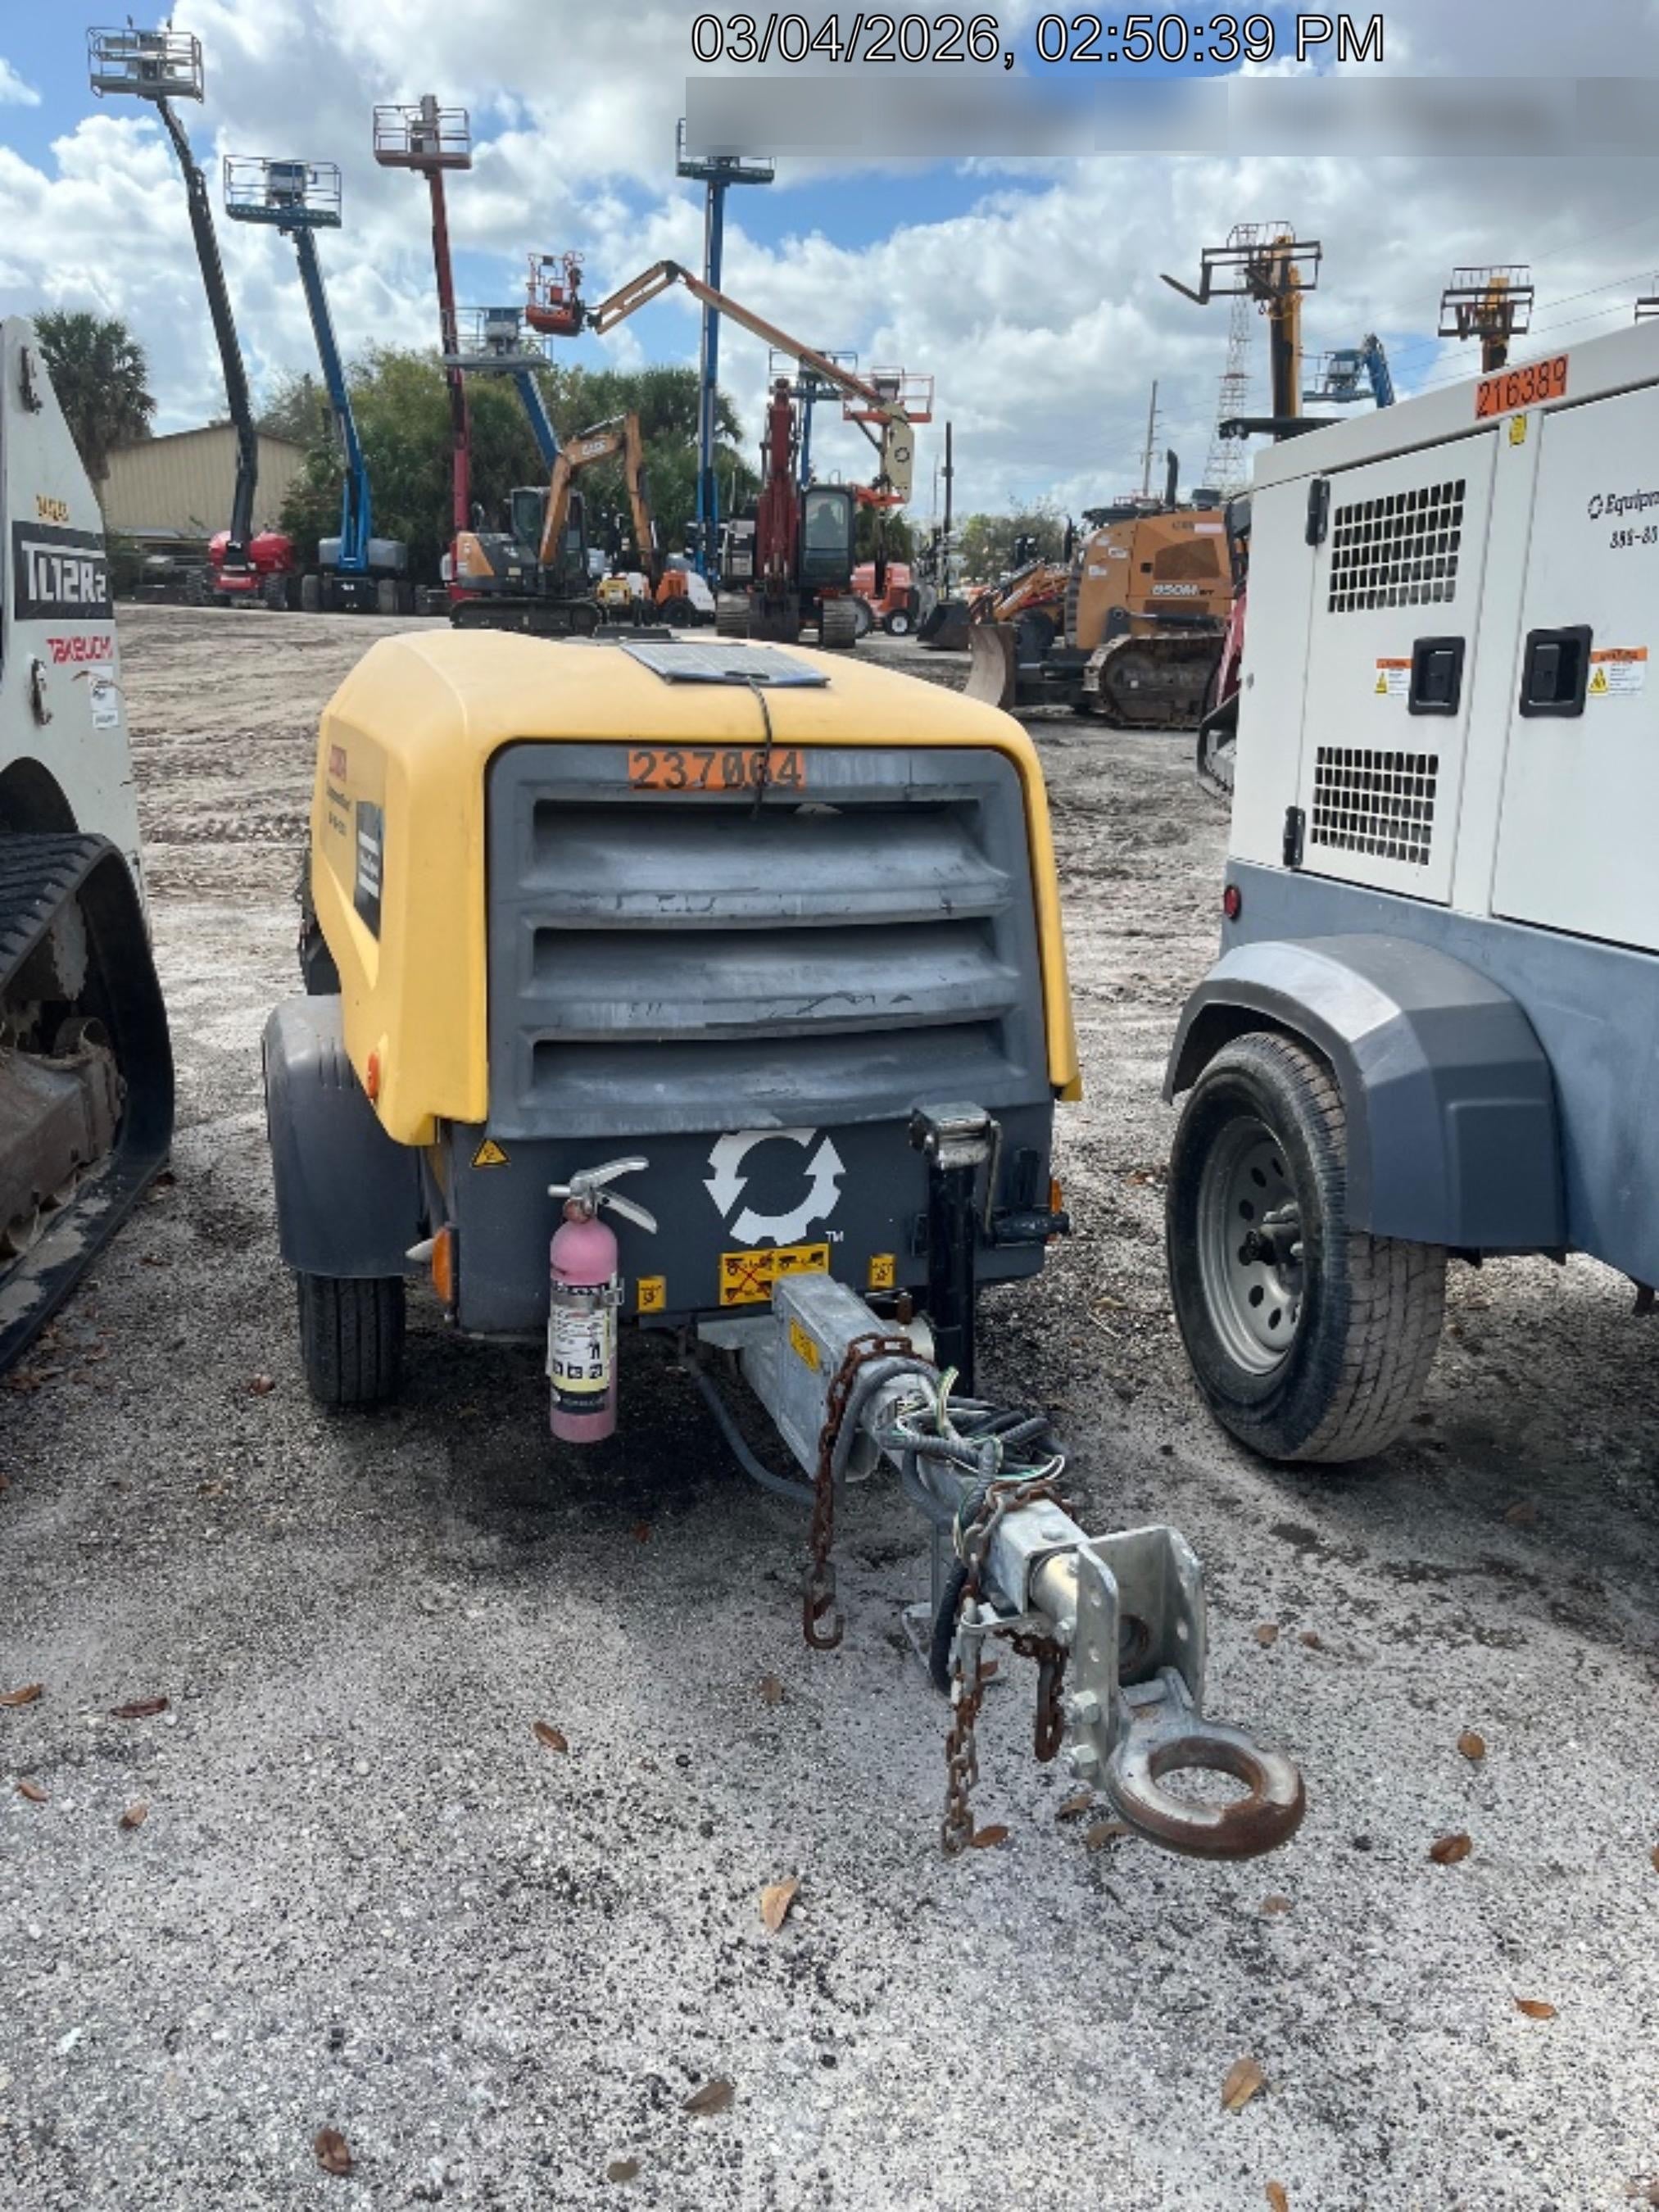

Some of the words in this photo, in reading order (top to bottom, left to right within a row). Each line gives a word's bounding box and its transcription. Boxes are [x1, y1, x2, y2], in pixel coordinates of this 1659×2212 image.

[1475, 356, 1566, 419] 216389
[632, 750, 802, 789] 237064
[825, 1231, 844, 1242] TM
